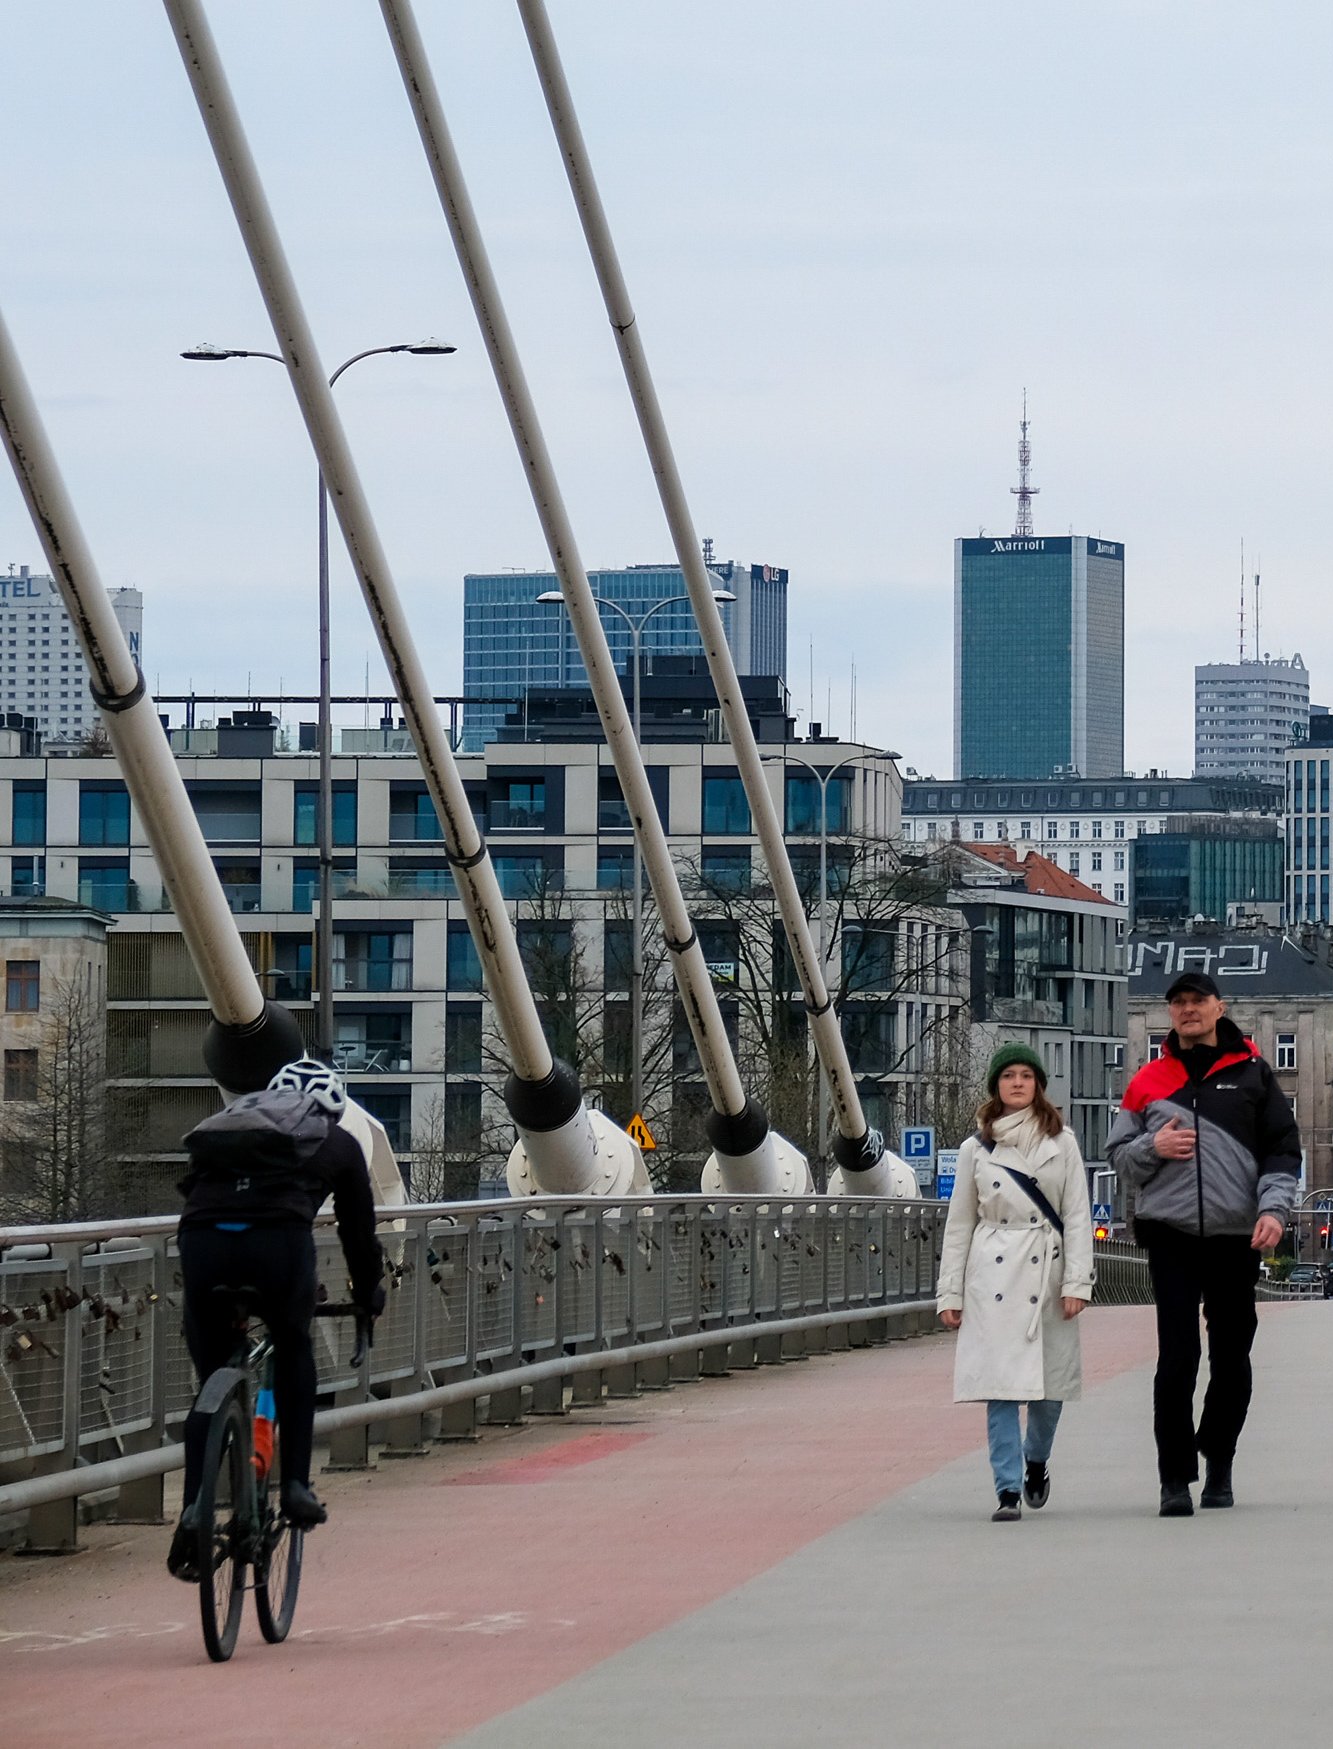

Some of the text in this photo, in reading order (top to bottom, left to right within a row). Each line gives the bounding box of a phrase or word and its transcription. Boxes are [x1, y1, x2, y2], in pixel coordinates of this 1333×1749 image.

[991, 540, 1045, 553] Marriott
[770, 567, 780, 581] LG
[910, 1133, 926, 1154] P
